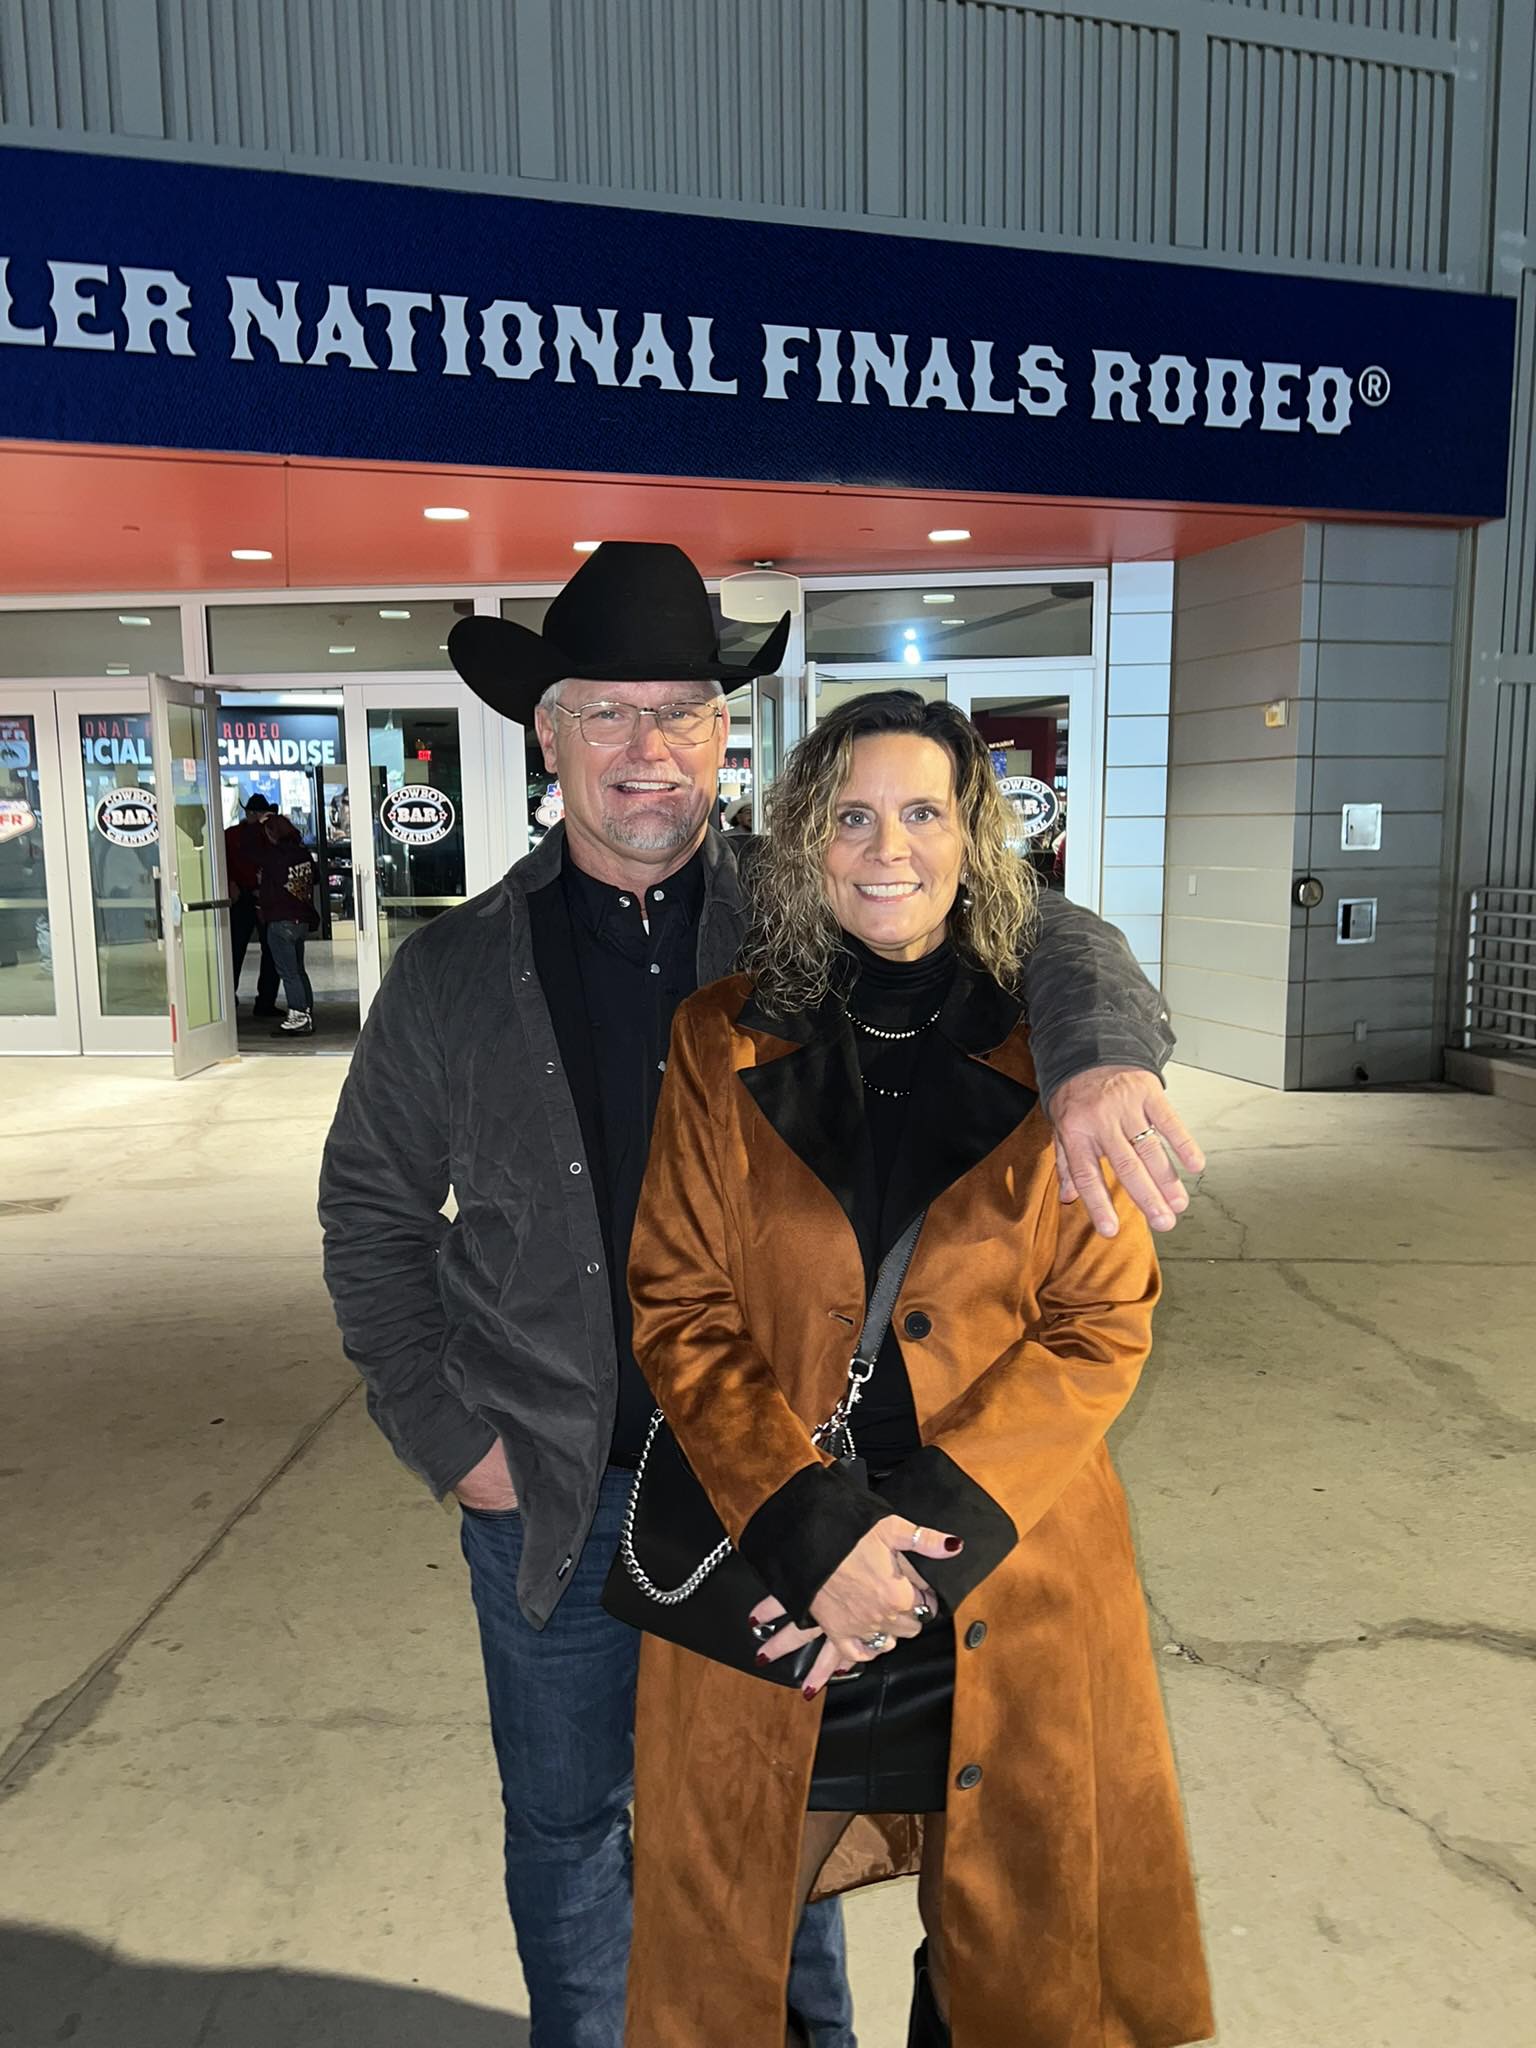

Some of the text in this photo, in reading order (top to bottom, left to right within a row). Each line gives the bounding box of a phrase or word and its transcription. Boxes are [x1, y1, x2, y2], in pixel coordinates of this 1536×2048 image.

[226, 276, 738, 395] NATIONAL
[762, 323, 1068, 417] FINALS
[222, 722, 279, 738] RODEO
[104, 791, 157, 808] COWBOY
[390, 788, 447, 804] COWBOY
[110, 808, 151, 826] BAR
[397, 807, 438, 823] BAR
[391, 826, 446, 842] CHANNEL
